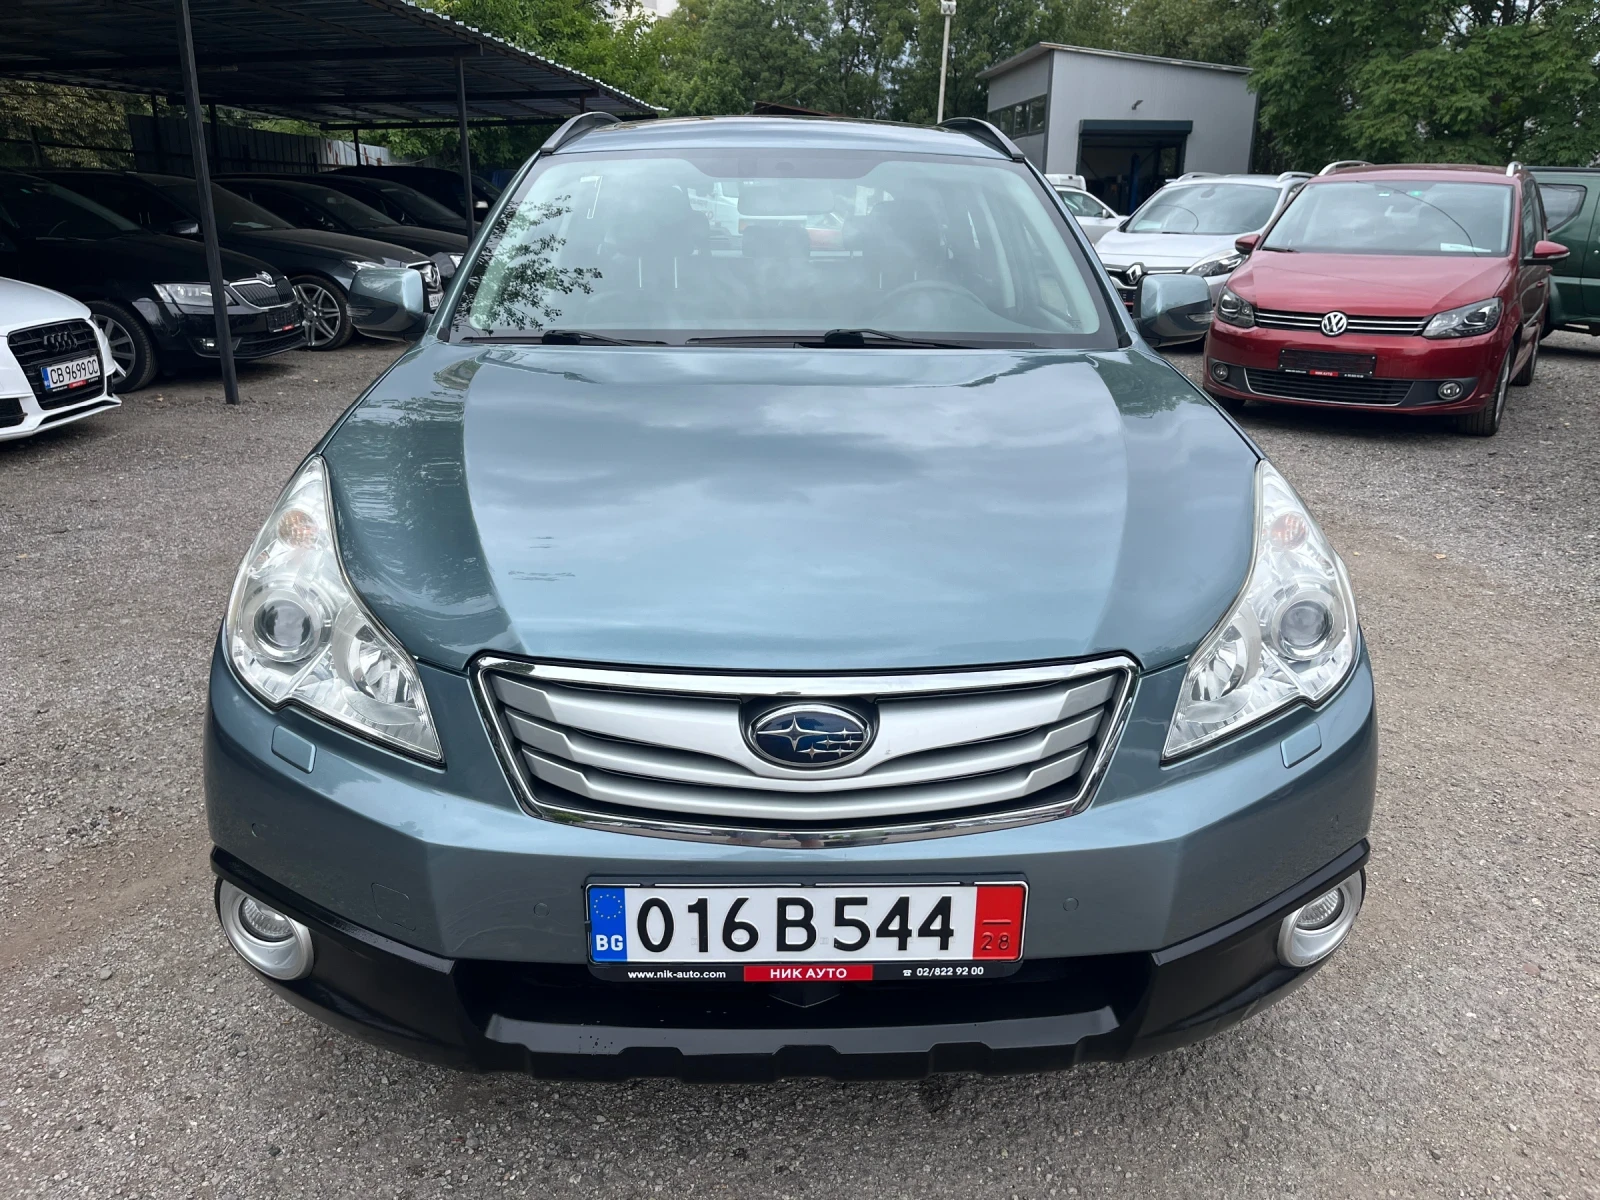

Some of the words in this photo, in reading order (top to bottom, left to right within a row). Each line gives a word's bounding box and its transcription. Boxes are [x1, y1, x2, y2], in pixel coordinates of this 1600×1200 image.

[50, 367, 65, 385] CB
[64, 362, 87, 382] 9699
[86, 359, 99, 375] CC
[637, 897, 760, 953] 016
[776, 897, 817, 952] B
[833, 896, 955, 952] 544
[595, 934, 624, 951] BG
[981, 931, 1010, 951] 28
[627, 969, 727, 980] www.nik-auto.com
[769, 967, 802, 979] НИК
[805, 967, 848, 979] АУТО
[916, 967, 953, 977] 02/822
[956, 966, 971, 976] 92
[971, 966, 984, 976] 00
